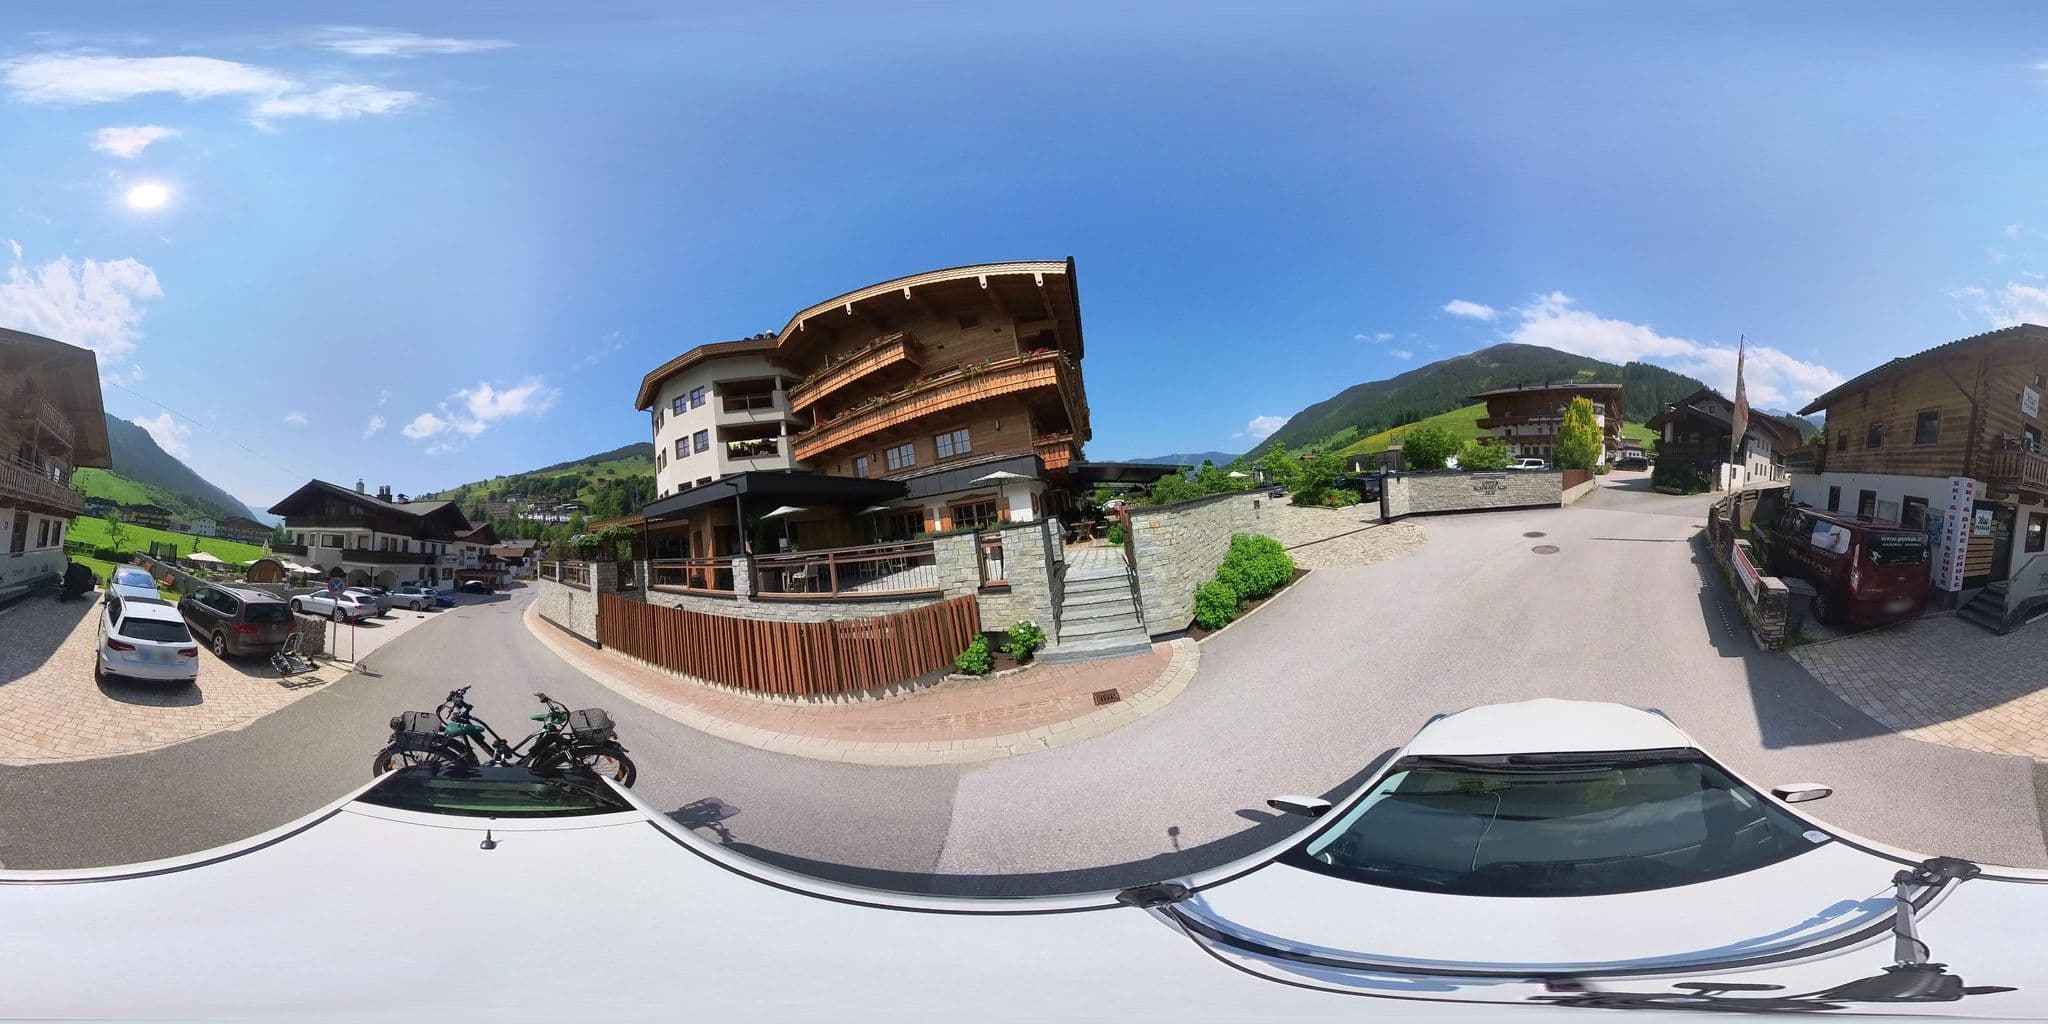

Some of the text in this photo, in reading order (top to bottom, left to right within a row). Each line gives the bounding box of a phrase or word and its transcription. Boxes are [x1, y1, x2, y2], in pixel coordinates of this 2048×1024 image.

[1952, 480, 1960, 500] SKI
[1965, 482, 1973, 502] SKI
[1946, 514, 1955, 542] BIKE
[1960, 516, 1969, 544] BIKE
[1940, 545, 1951, 586] SCHULE
[1954, 547, 1965, 588] SCHULE
